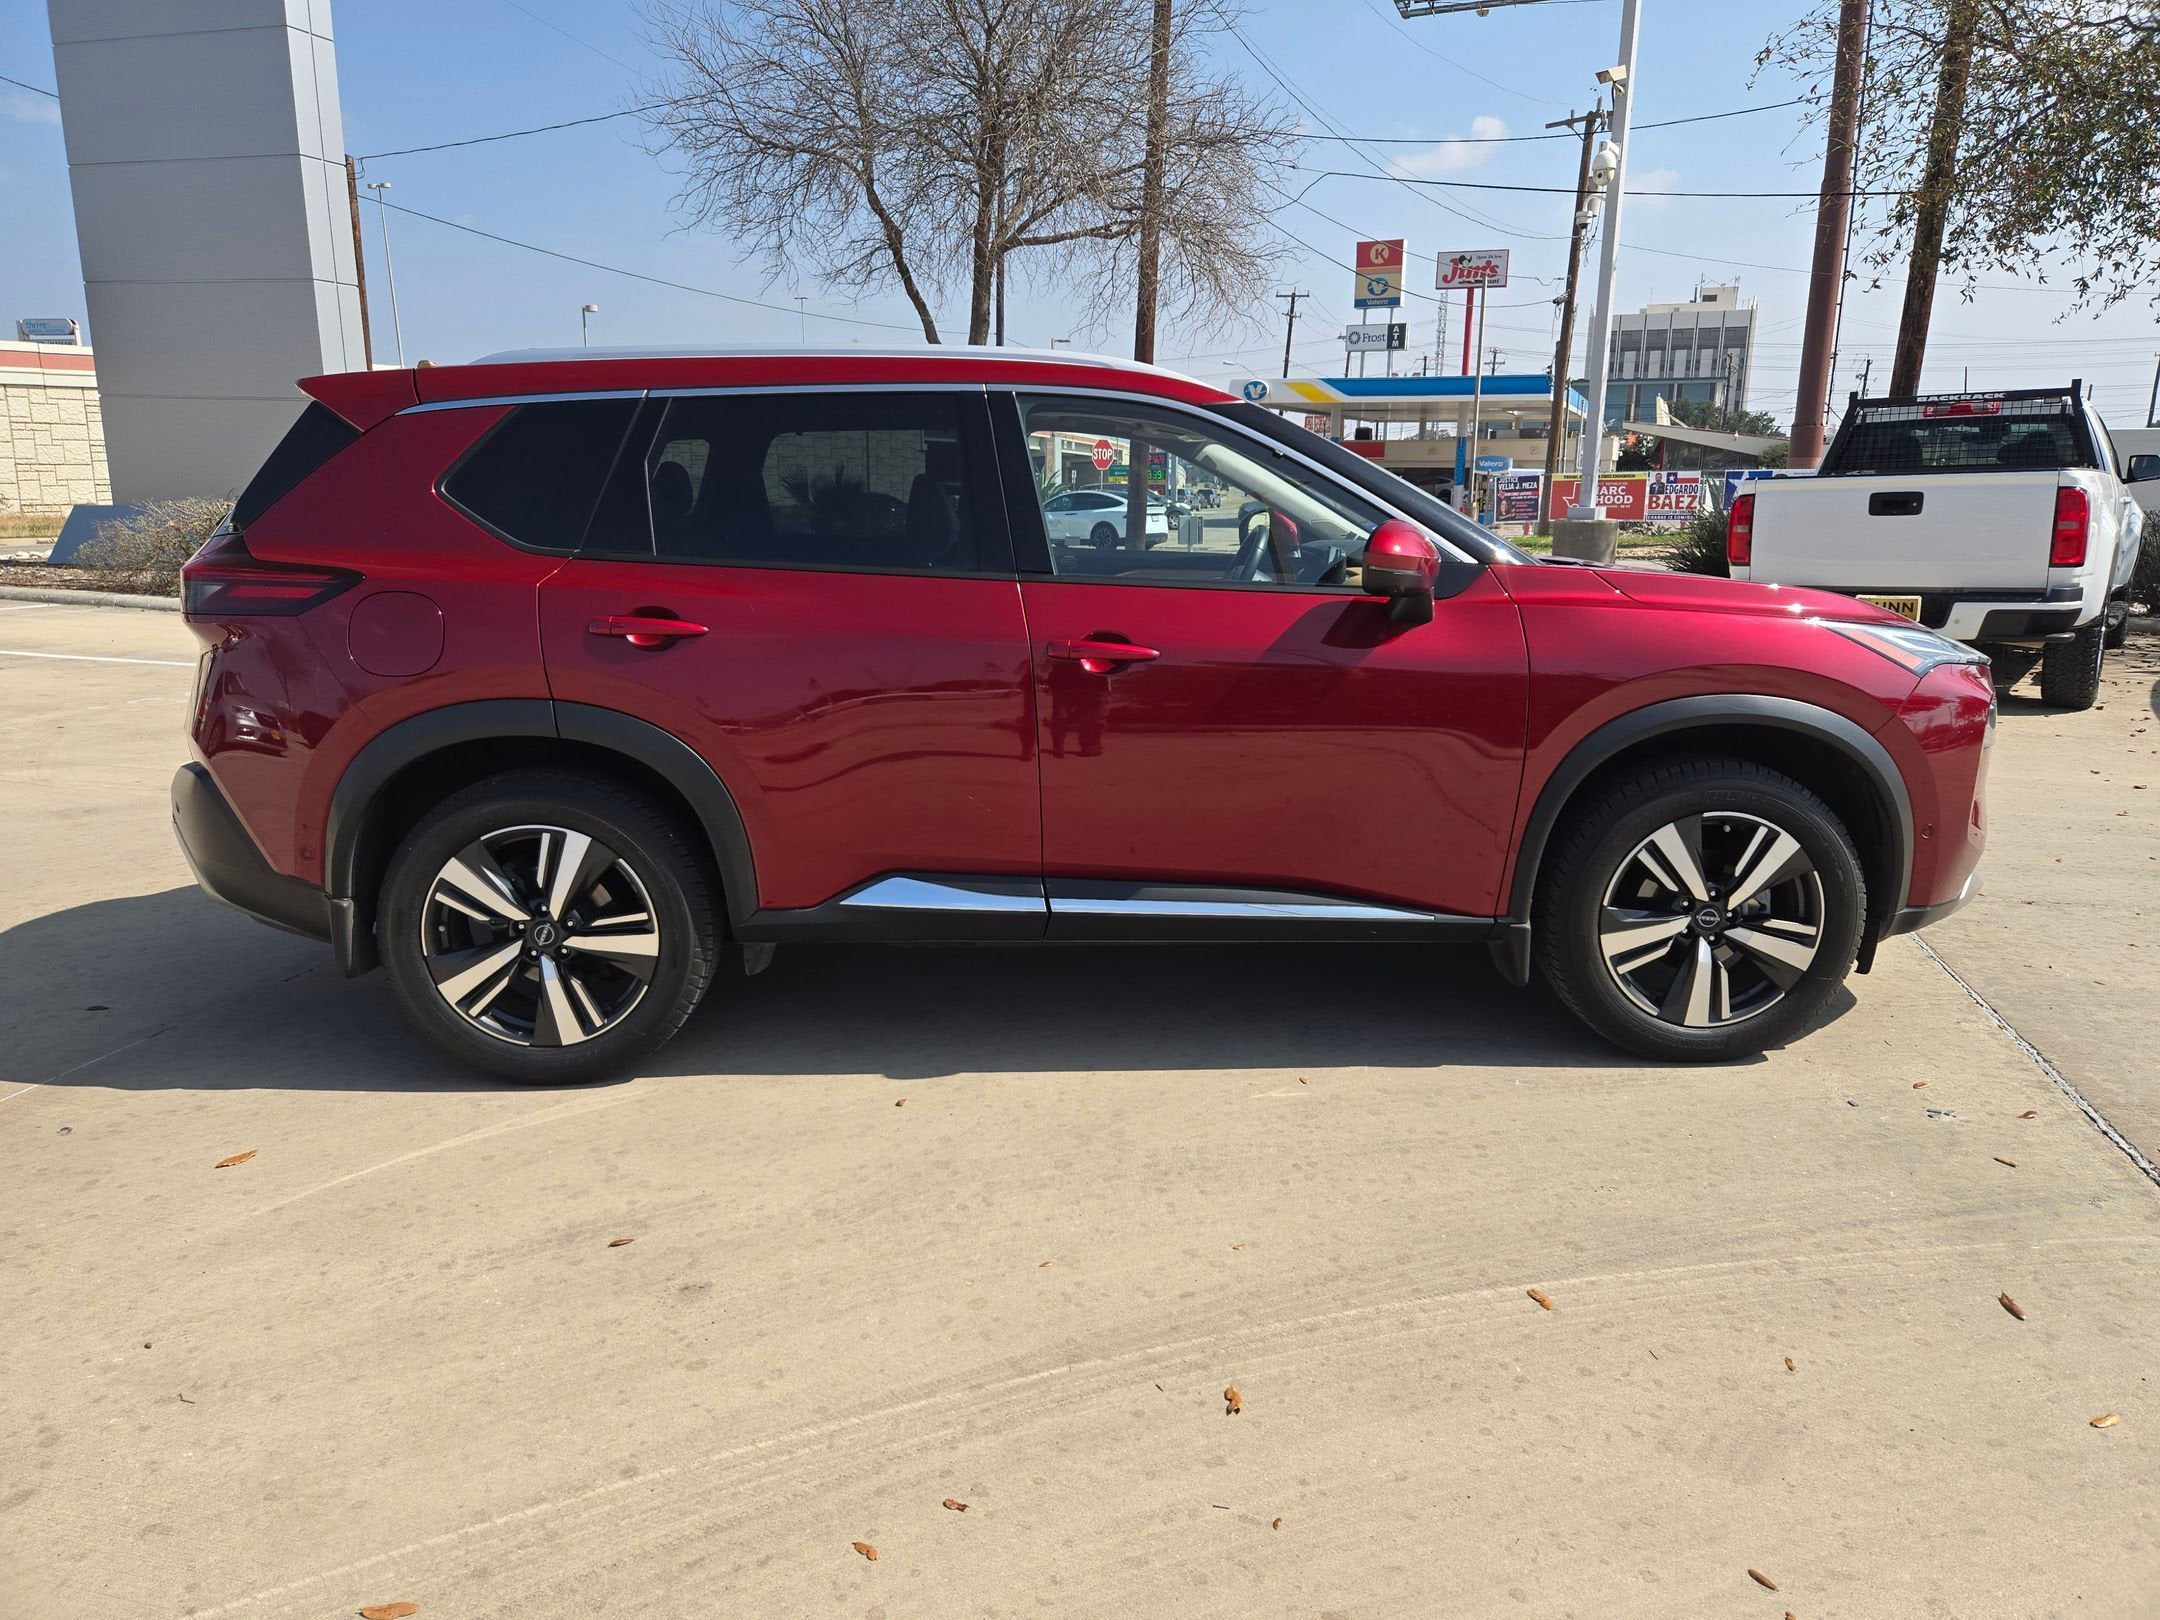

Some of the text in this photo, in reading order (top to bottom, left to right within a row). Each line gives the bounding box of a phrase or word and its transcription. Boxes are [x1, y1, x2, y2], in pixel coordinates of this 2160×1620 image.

[1442, 257, 1499, 284] Jim's
[1362, 332, 1386, 343] Frost
[1917, 393, 2006, 402] BACKRACK
[1093, 448, 1113, 460] STOP
[1665, 484, 1699, 495] EDGARDO
[1648, 494, 1698, 510] BAEZ
